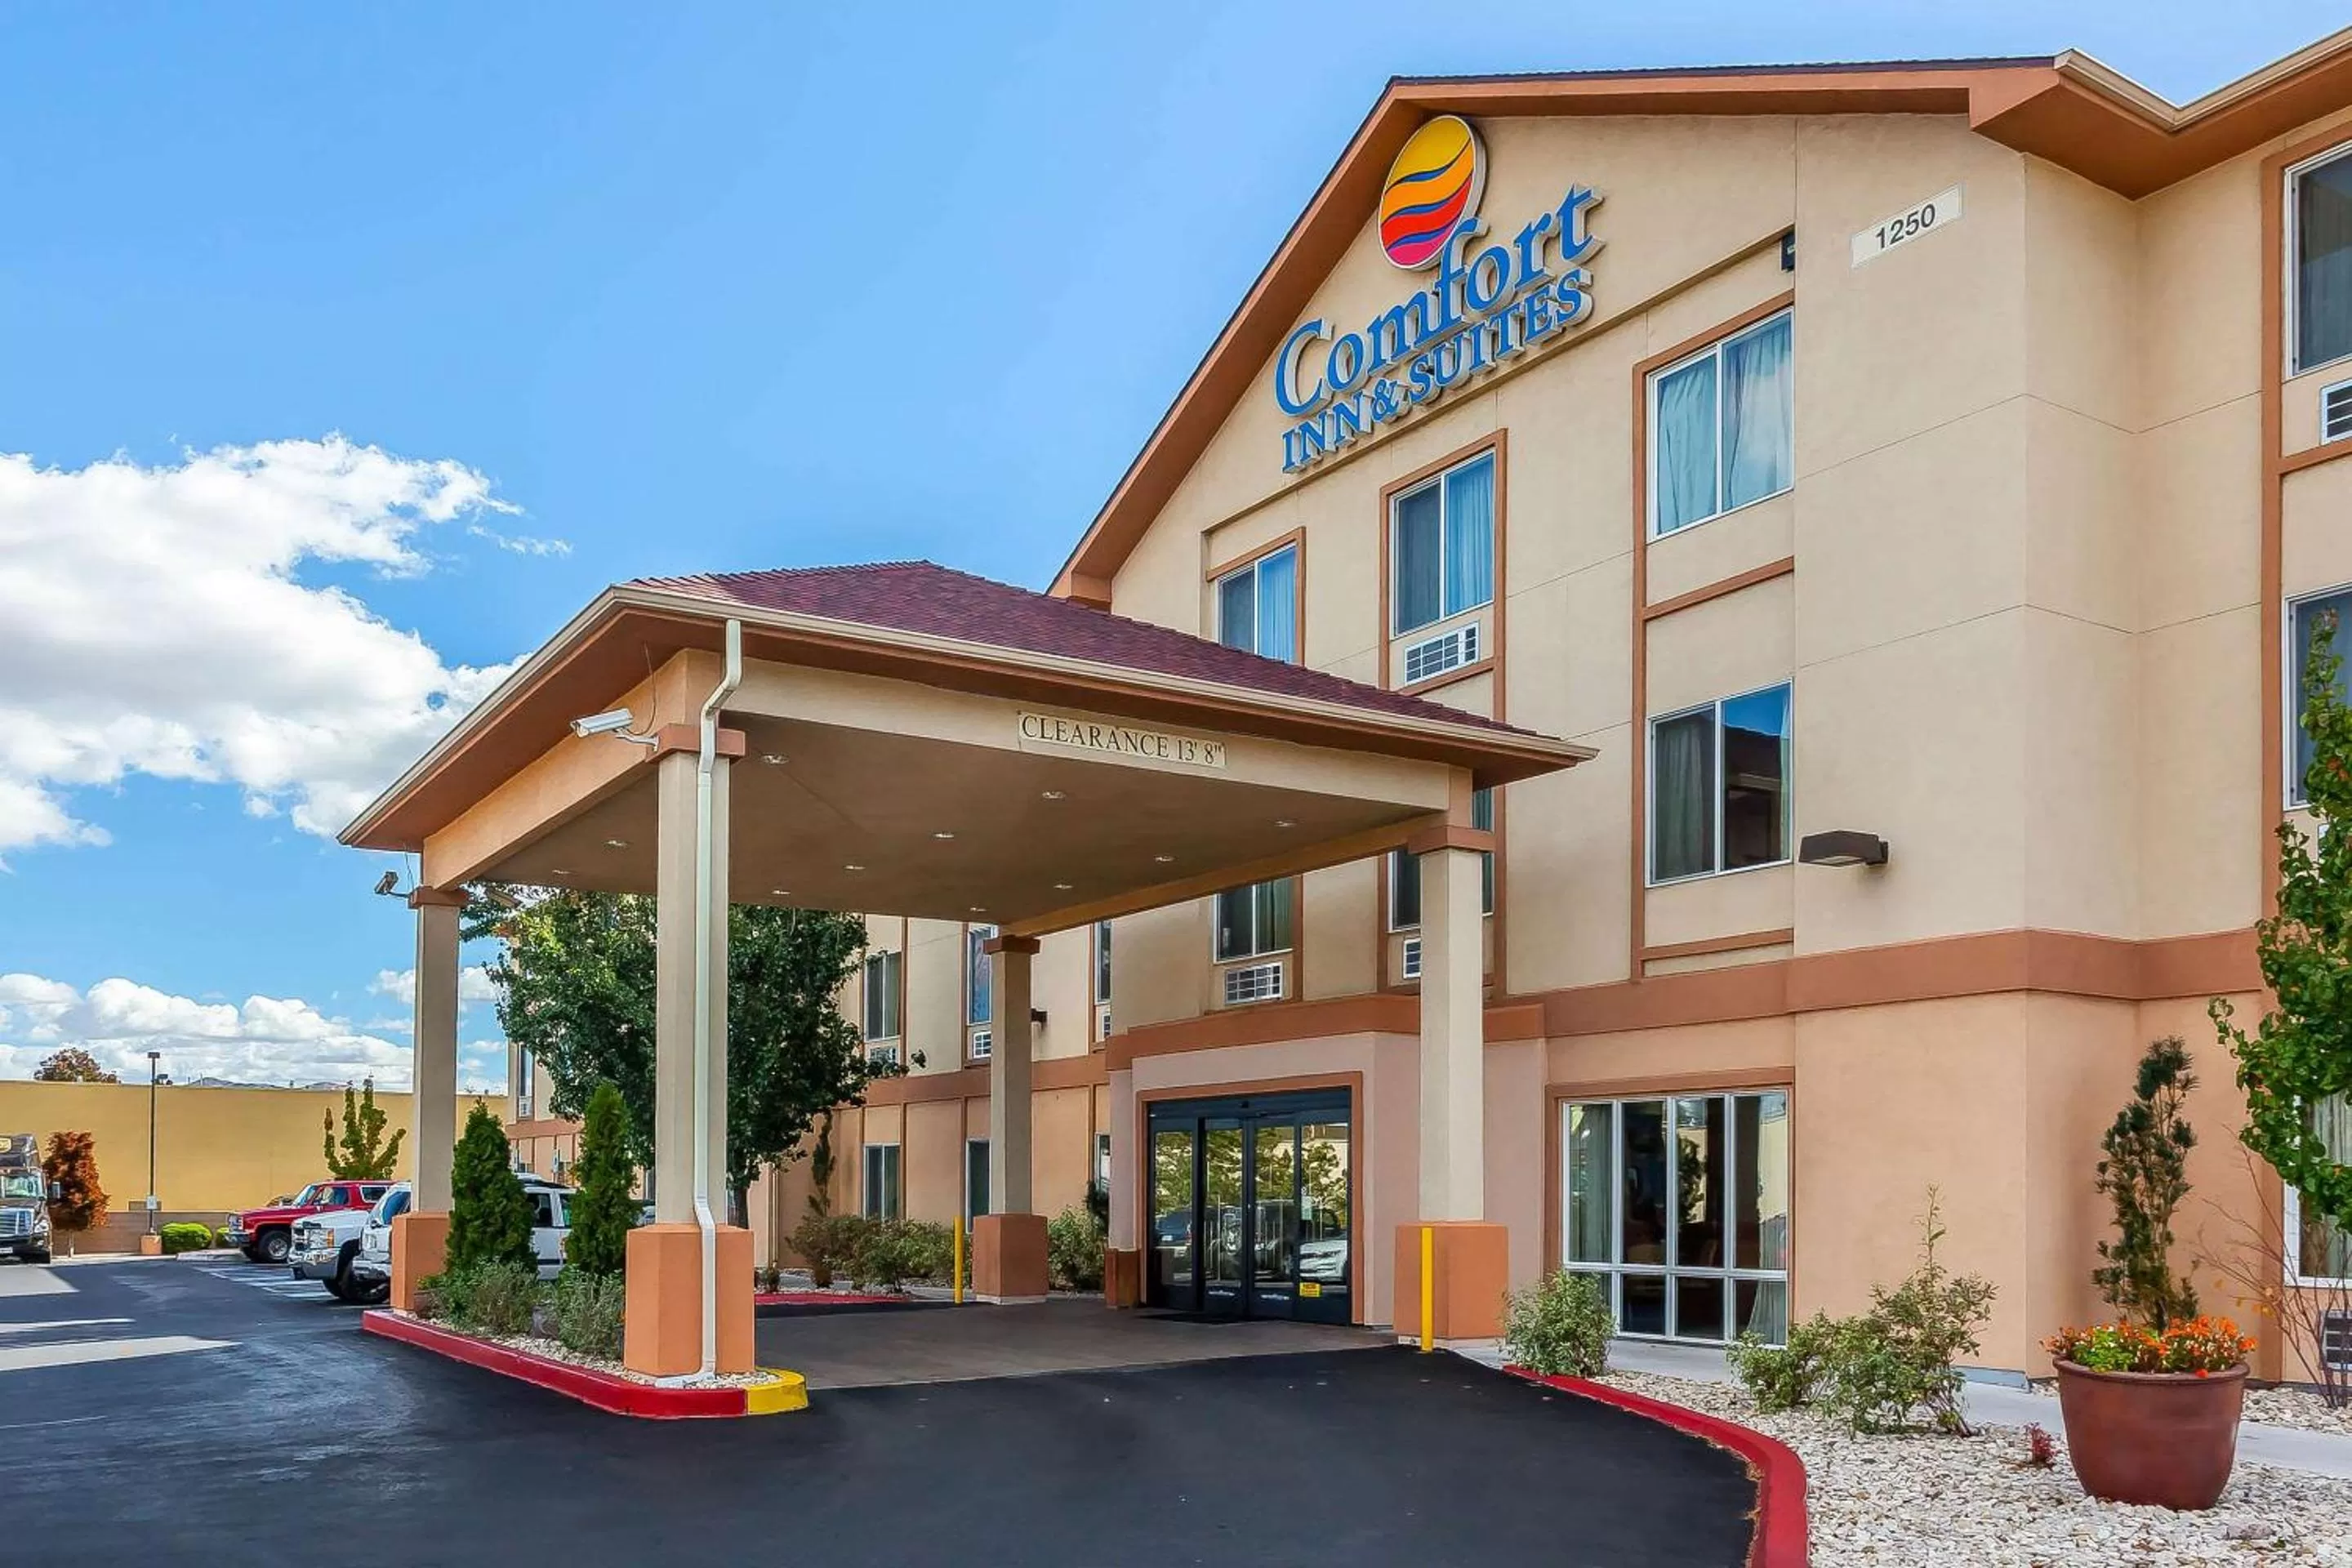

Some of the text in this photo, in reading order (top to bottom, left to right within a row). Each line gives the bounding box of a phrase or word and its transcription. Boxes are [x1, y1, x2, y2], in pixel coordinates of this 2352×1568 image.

[1875, 203, 1936, 248] 1250
[1274, 181, 1605, 417] Comfort
[1281, 268, 1592, 474] INN & SUITES
[1022, 715, 1169, 757] CLEARANCE
[1177, 739, 1197, 761] 13'
